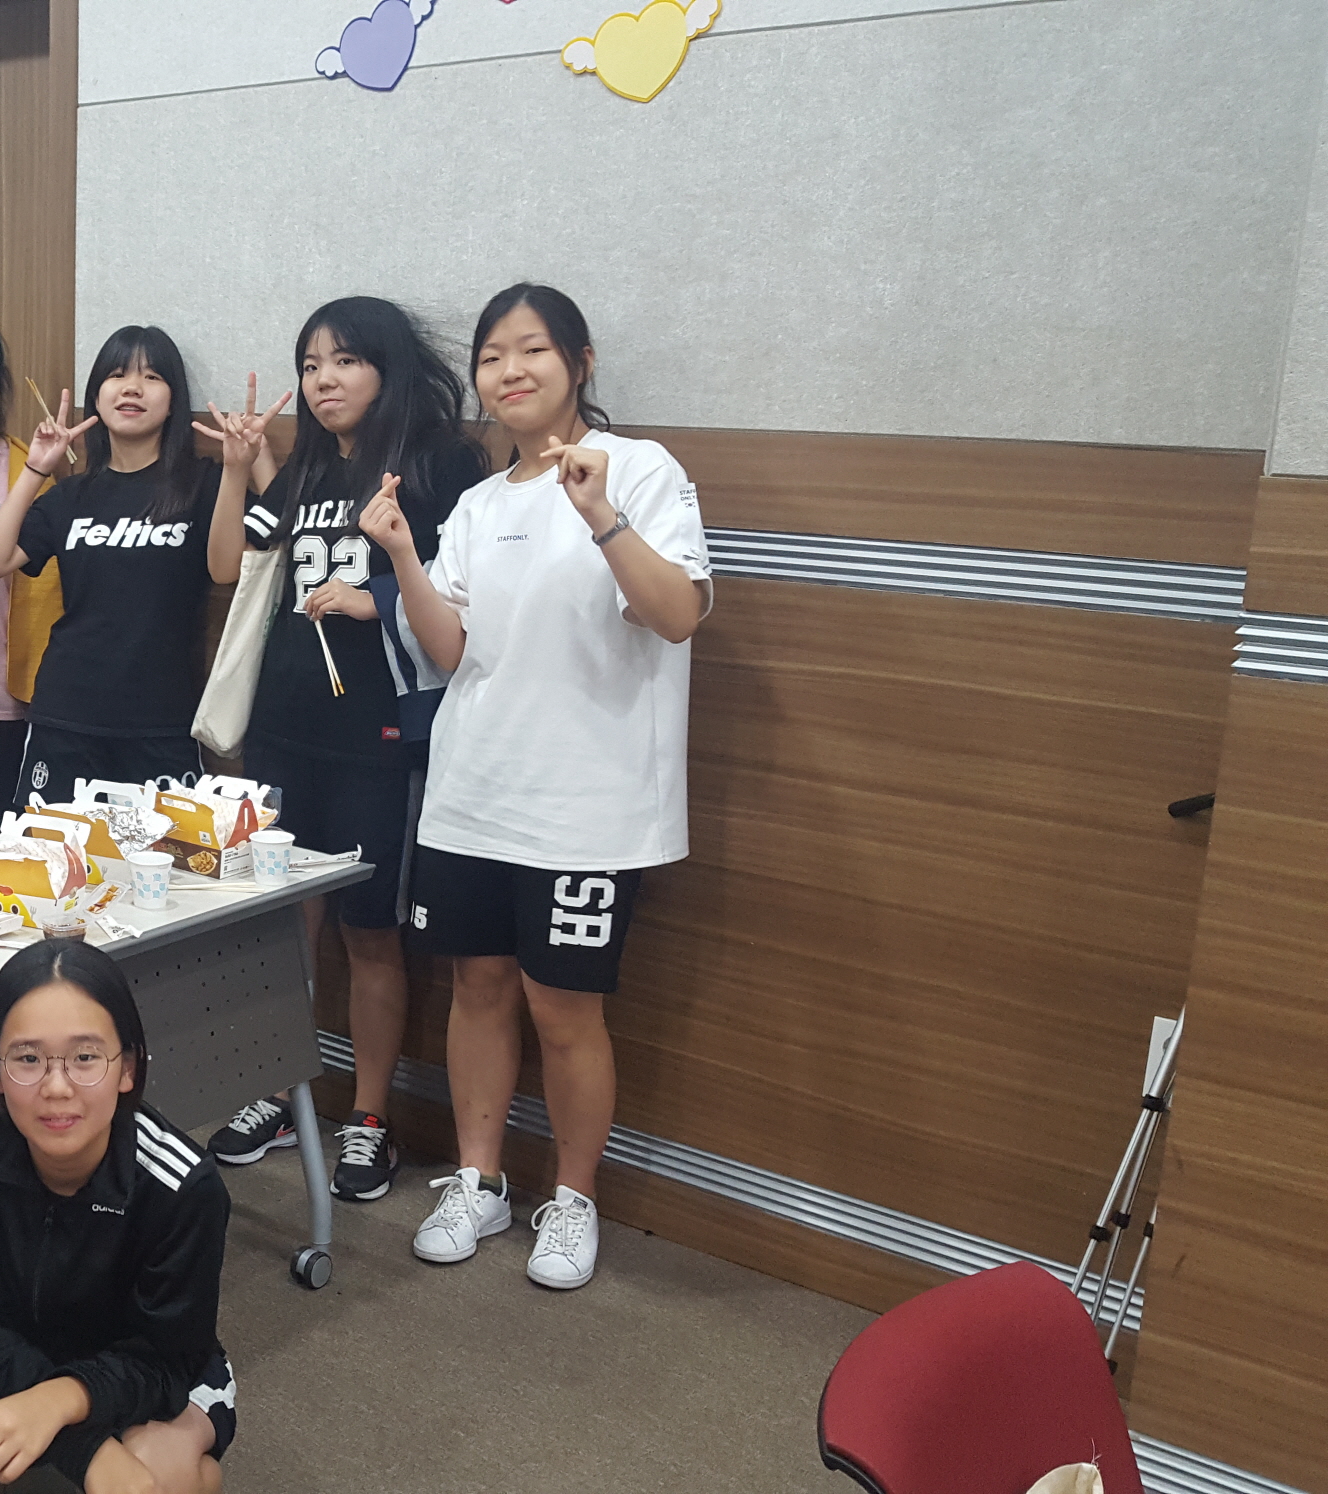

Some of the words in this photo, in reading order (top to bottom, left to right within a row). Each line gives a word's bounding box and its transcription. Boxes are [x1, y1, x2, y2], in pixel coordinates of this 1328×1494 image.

[65, 516, 189, 550] Feltics
[293, 535, 371, 614] 22
[410, 901, 428, 930] 5
